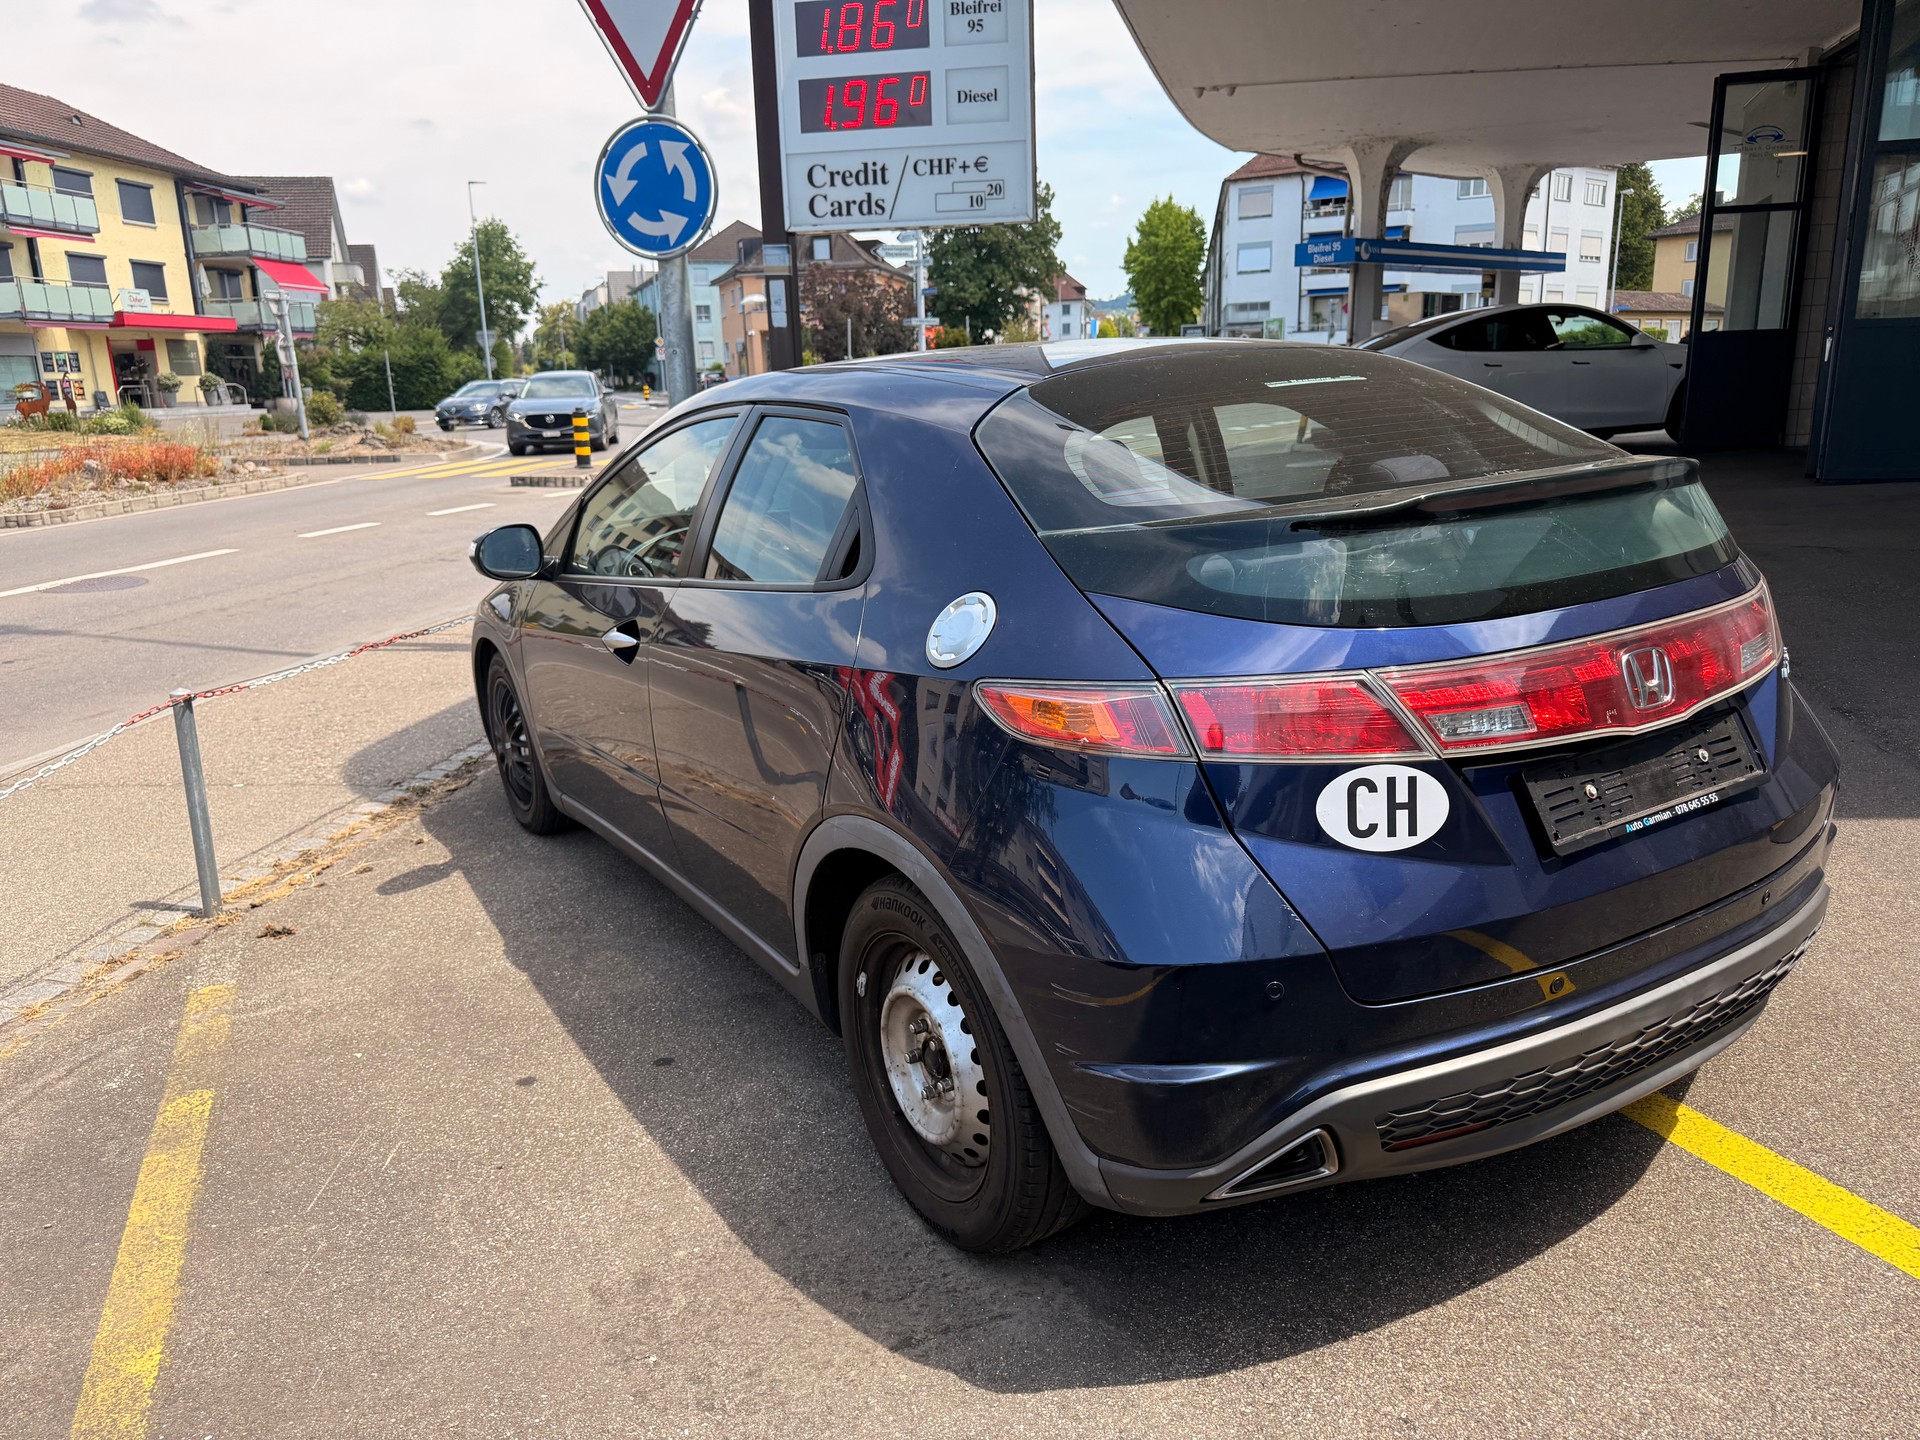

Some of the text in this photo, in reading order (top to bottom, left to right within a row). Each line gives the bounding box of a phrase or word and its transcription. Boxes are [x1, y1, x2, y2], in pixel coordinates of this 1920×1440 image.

[950, 0, 1003, 16] Bleifrei
[967, 18, 984, 34] 95
[956, 88, 998, 104] Diesel
[806, 161, 890, 189] Credit
[986, 183, 1002, 197] 20
[807, 192, 886, 219] Cards
[968, 194, 984, 208] 10
[1307, 241, 1342, 255] Bleifrei 95
[1313, 253, 1335, 264] Diesel
[1346, 775, 1418, 839] CH
[1625, 820, 1643, 833] Auto
[1643, 809, 1672, 827] Garmian
[1675, 803, 1689, 816] 078
[1688, 798, 1702, 811] 645
[1701, 796, 1710, 807] 55
[1709, 792, 1719, 804] 55
